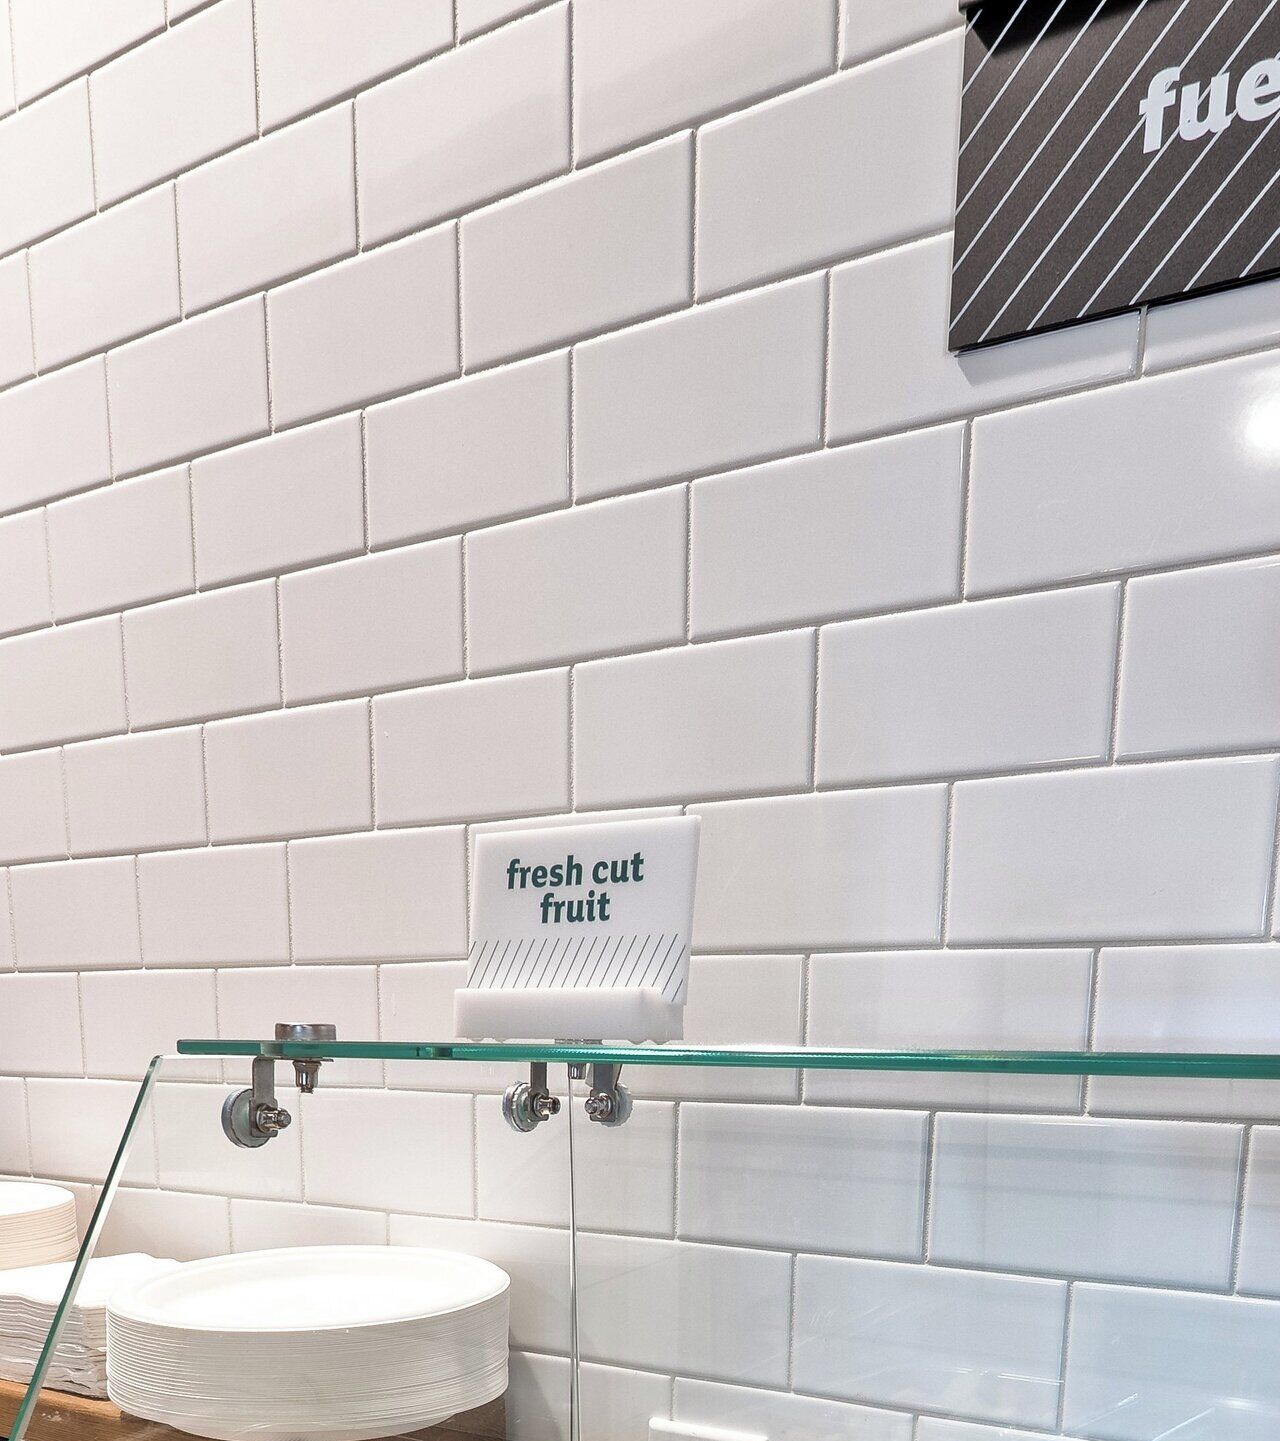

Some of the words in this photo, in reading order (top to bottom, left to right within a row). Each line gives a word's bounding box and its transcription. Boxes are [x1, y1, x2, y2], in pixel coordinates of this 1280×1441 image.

[506, 854, 583, 890] fresh
[591, 852, 645, 885] cut
[540, 889, 611, 925] fruit
